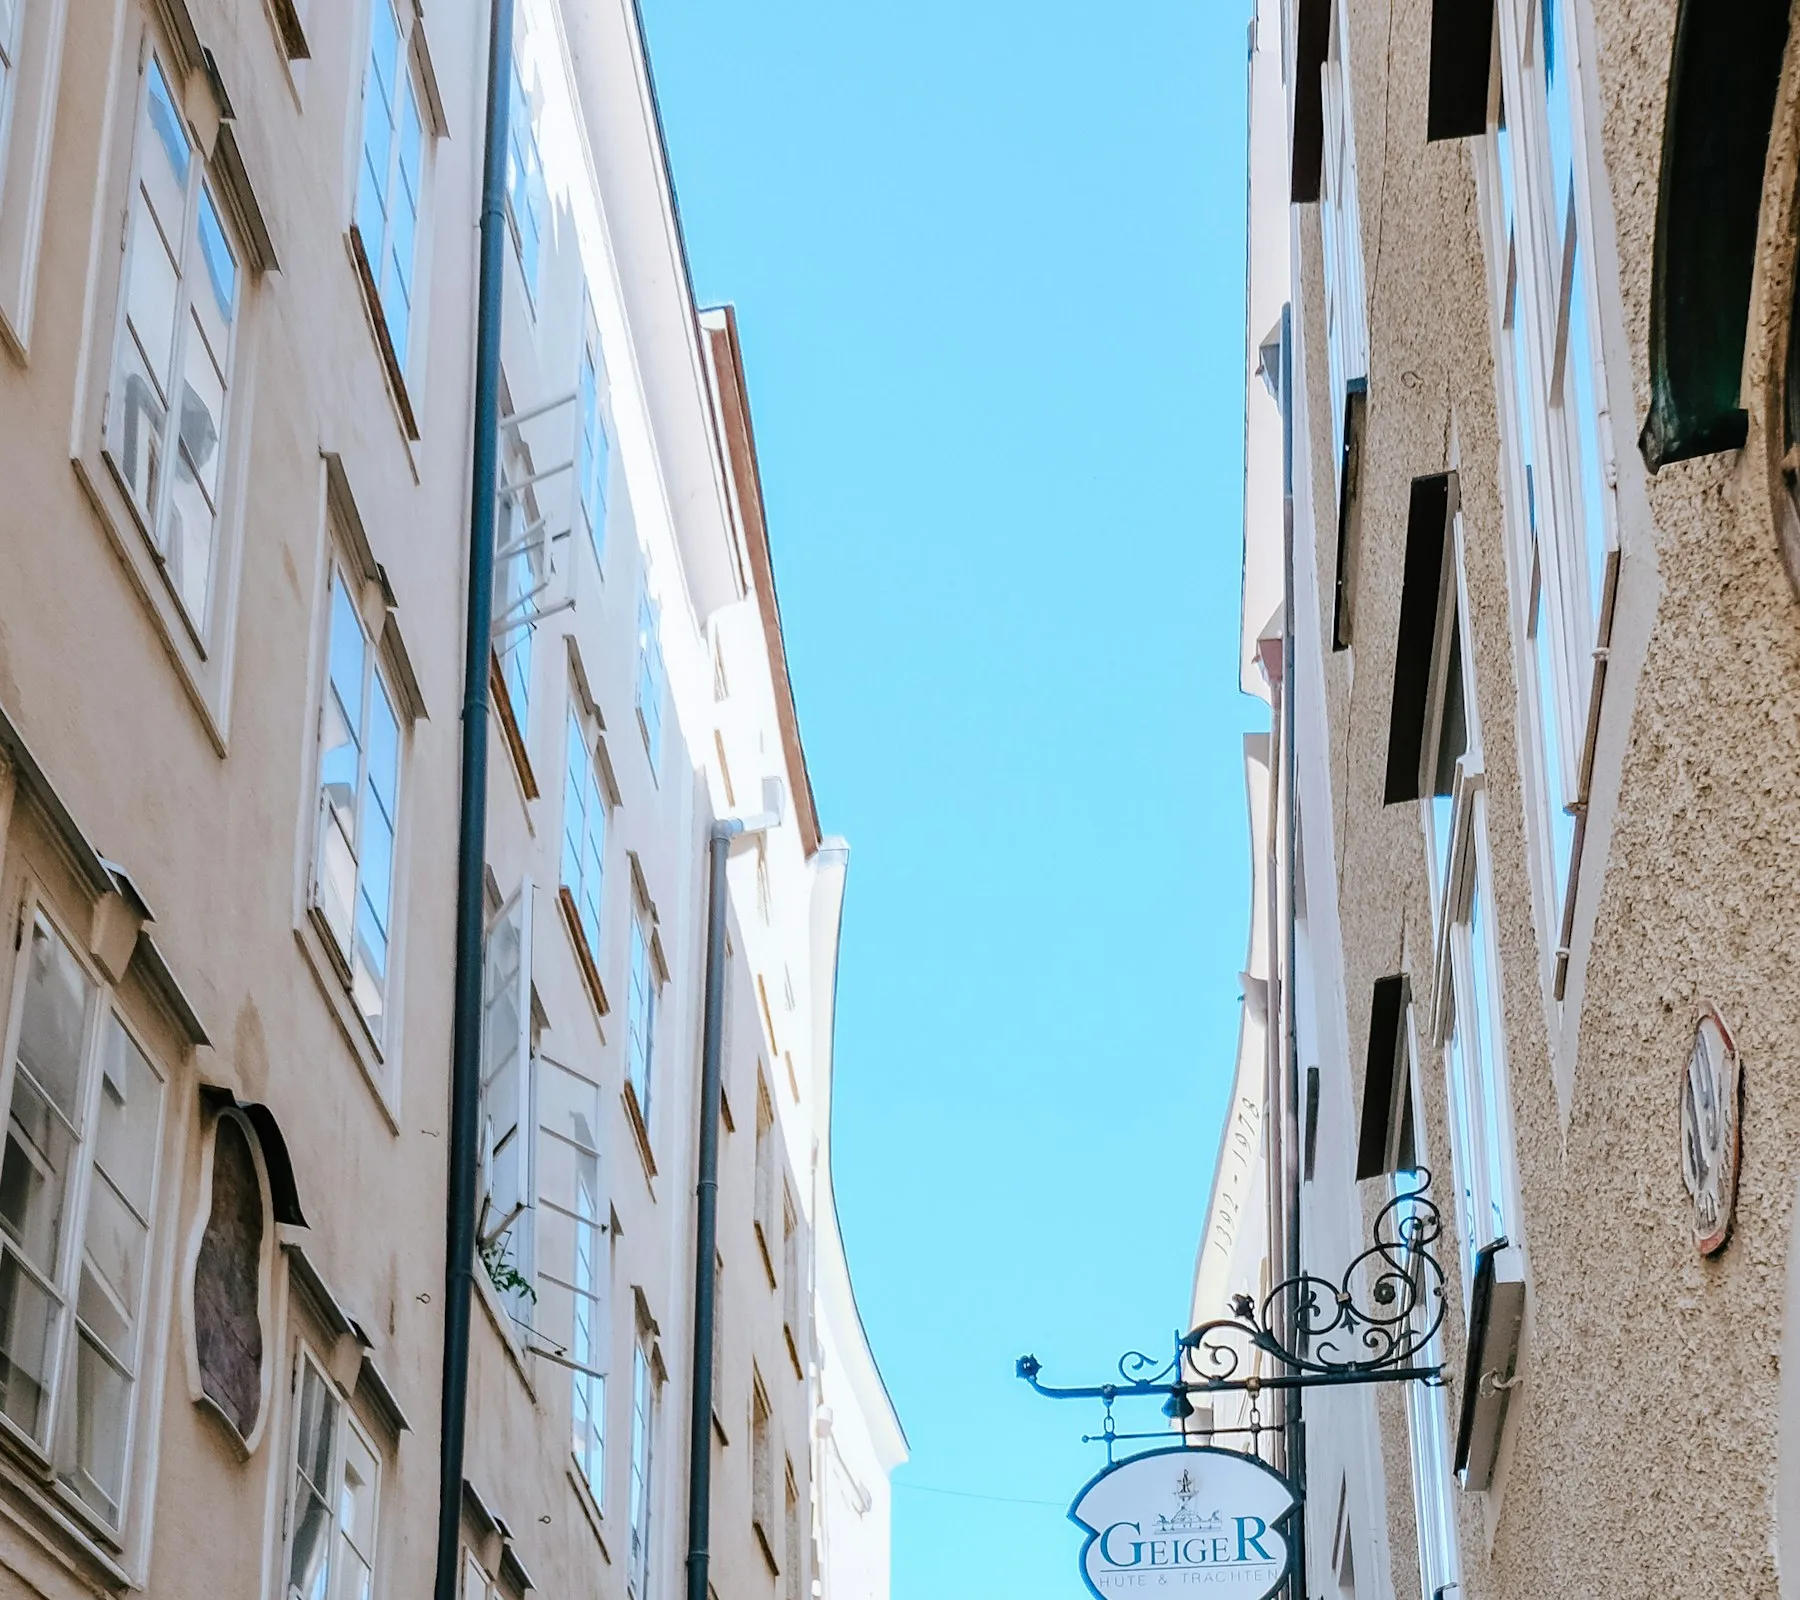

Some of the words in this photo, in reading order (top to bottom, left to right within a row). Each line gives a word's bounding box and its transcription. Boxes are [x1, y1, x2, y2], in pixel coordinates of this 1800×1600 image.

[1214, 1193, 1239, 1257] 1392
[1231, 1097, 1260, 1169] 1978
[1100, 1516, 1276, 1567] GEIGER
[1158, 1573, 1167, 1586] &
[1182, 1568, 1278, 1585] TRACHTEN
